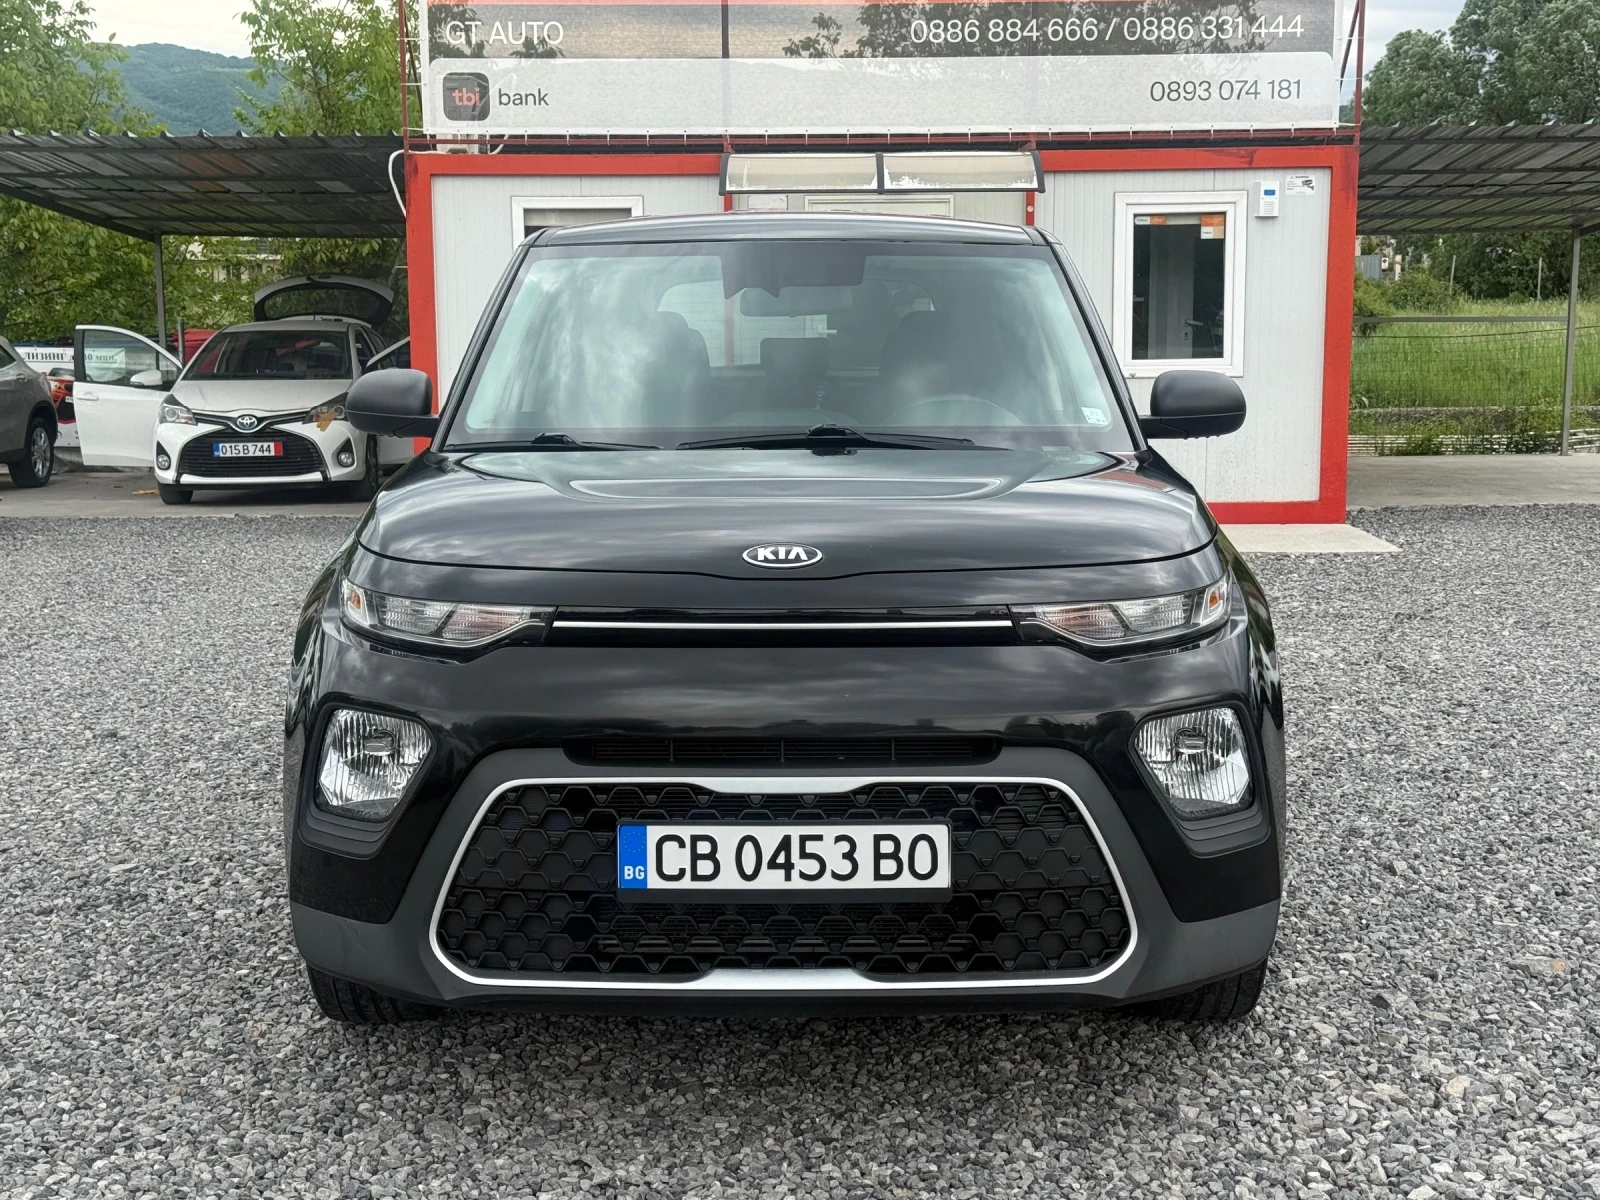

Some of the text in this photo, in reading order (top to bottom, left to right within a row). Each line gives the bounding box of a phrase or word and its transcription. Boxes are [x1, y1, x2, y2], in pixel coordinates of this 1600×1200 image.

[446, 21, 564, 45] GT AUTO
[911, 15, 1304, 42] 0886 884 666 / 0886 331 444
[452, 88, 549, 106] tbi bank
[1150, 79, 1301, 101] 0893 074 181
[757, 547, 808, 560] KIA
[655, 834, 721, 882] CB
[735, 834, 859, 881] 0453
[624, 866, 645, 880] BG
